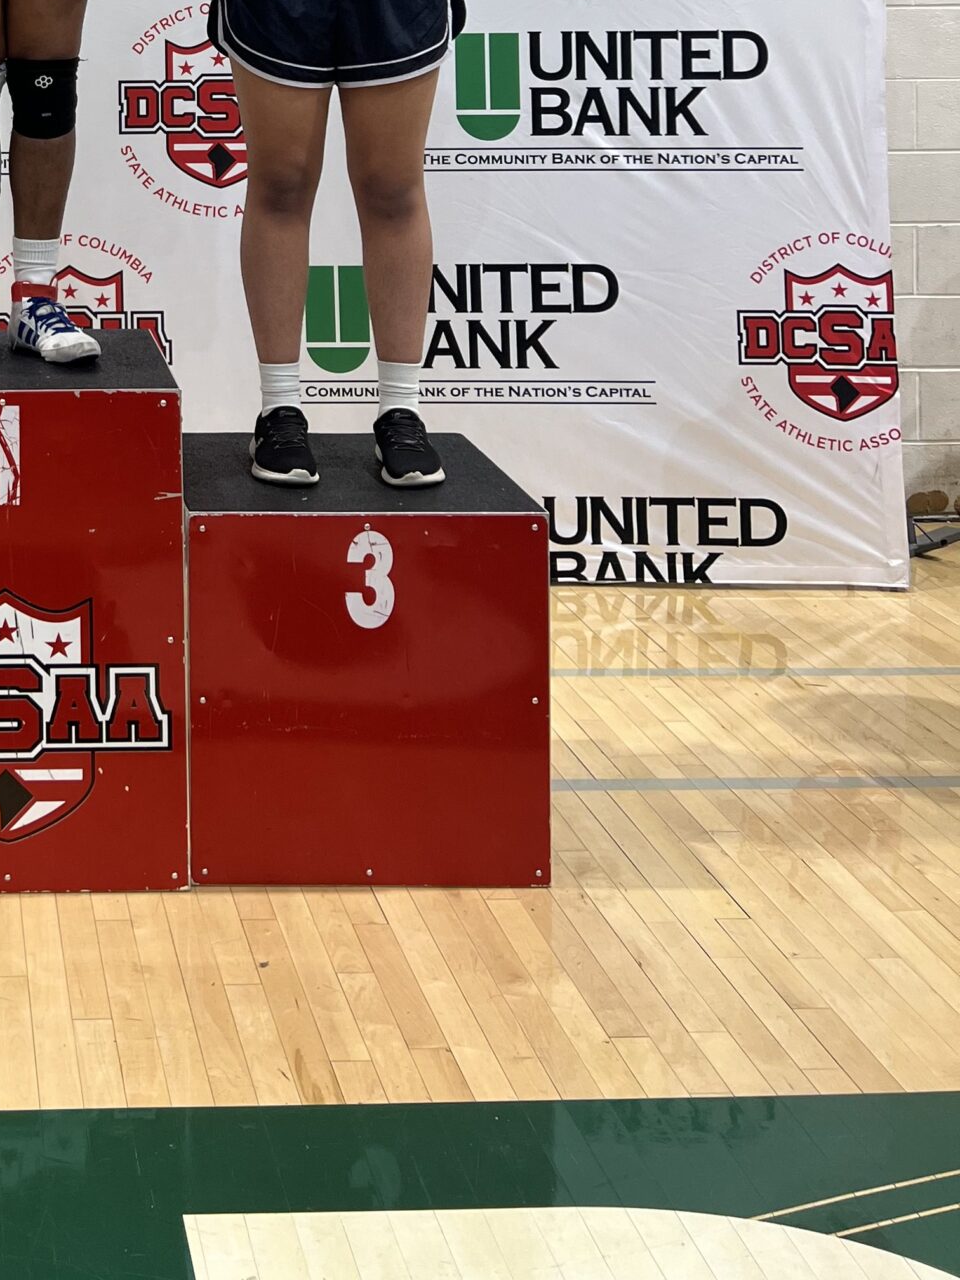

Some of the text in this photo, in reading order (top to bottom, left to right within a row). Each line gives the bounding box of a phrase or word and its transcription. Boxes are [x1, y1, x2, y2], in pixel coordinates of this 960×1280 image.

[131, 6, 194, 55] DISTRICT
[527, 30, 769, 82] UNITED
[529, 86, 709, 137] BANK
[120, 145, 228, 218] STATE ATHLETIC
[78, 235, 154, 285] COLUMBIA
[749, 232, 840, 284] DISTRICT OF
[429, 263, 620, 314] NITED
[421, 319, 560, 369] ANK
[737, 305, 896, 371] DCSA
[741, 376, 777, 421] STATE
[776, 420, 852, 452] ATHLETIC
[542, 496, 787, 546] UNITED
[345, 531, 395, 630] 3
[549, 551, 724, 583] BANK
